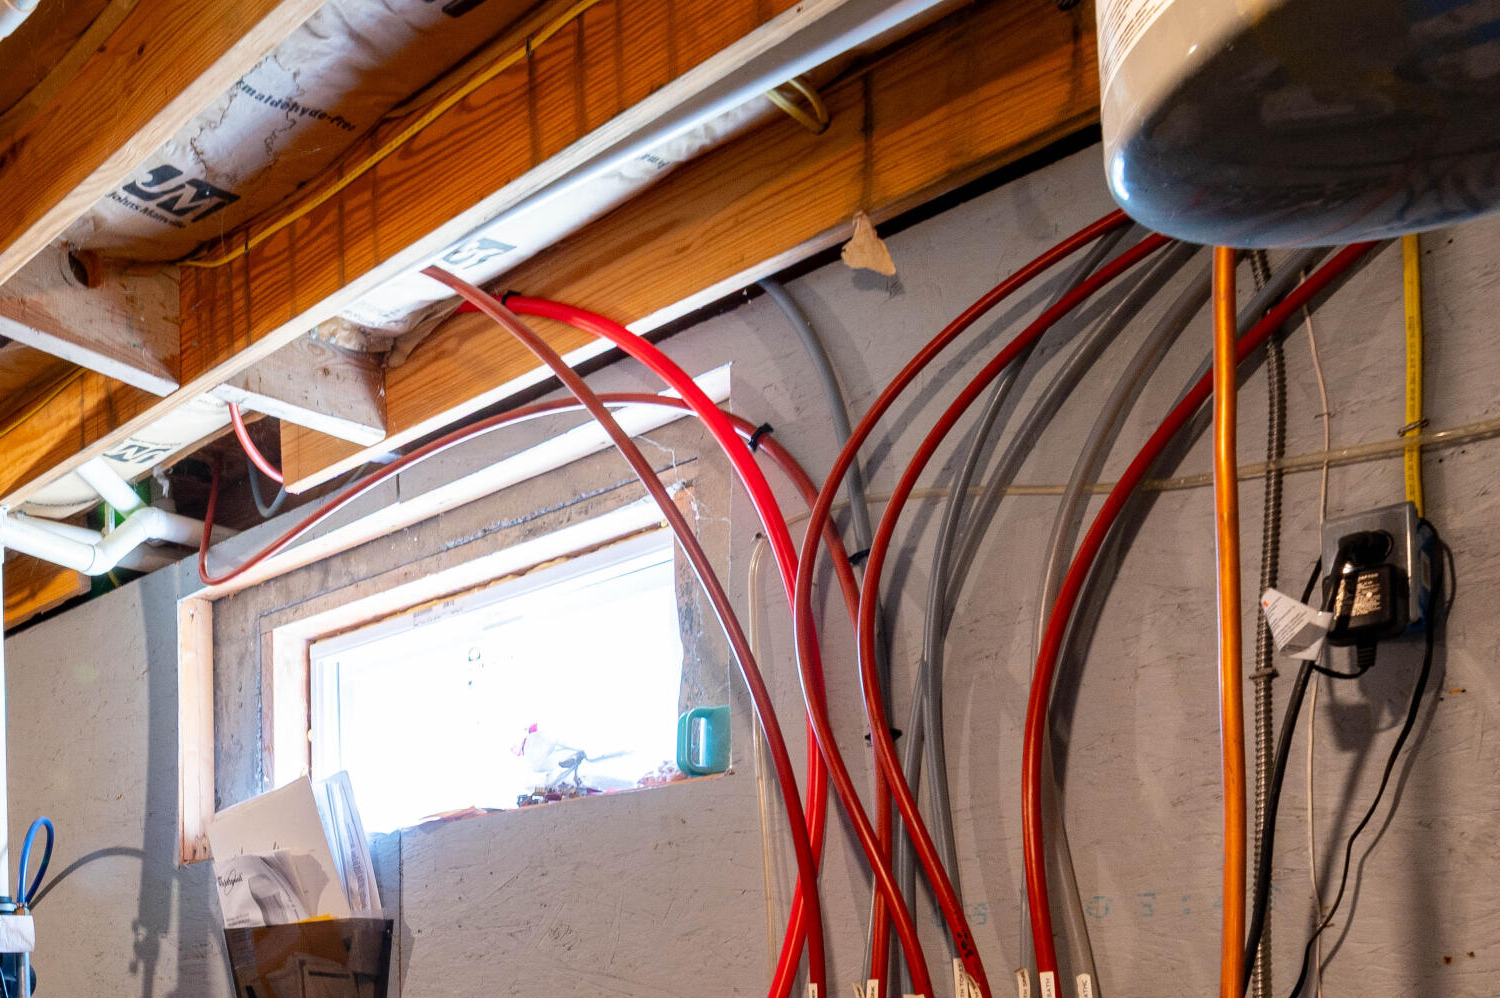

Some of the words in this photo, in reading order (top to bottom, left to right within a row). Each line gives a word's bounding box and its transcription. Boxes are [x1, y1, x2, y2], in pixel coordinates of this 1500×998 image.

[105, 192, 141, 212] Johns
[140, 205, 187, 229] Manville
[122, 165, 241, 223] JM
[103, 442, 174, 463] JM
